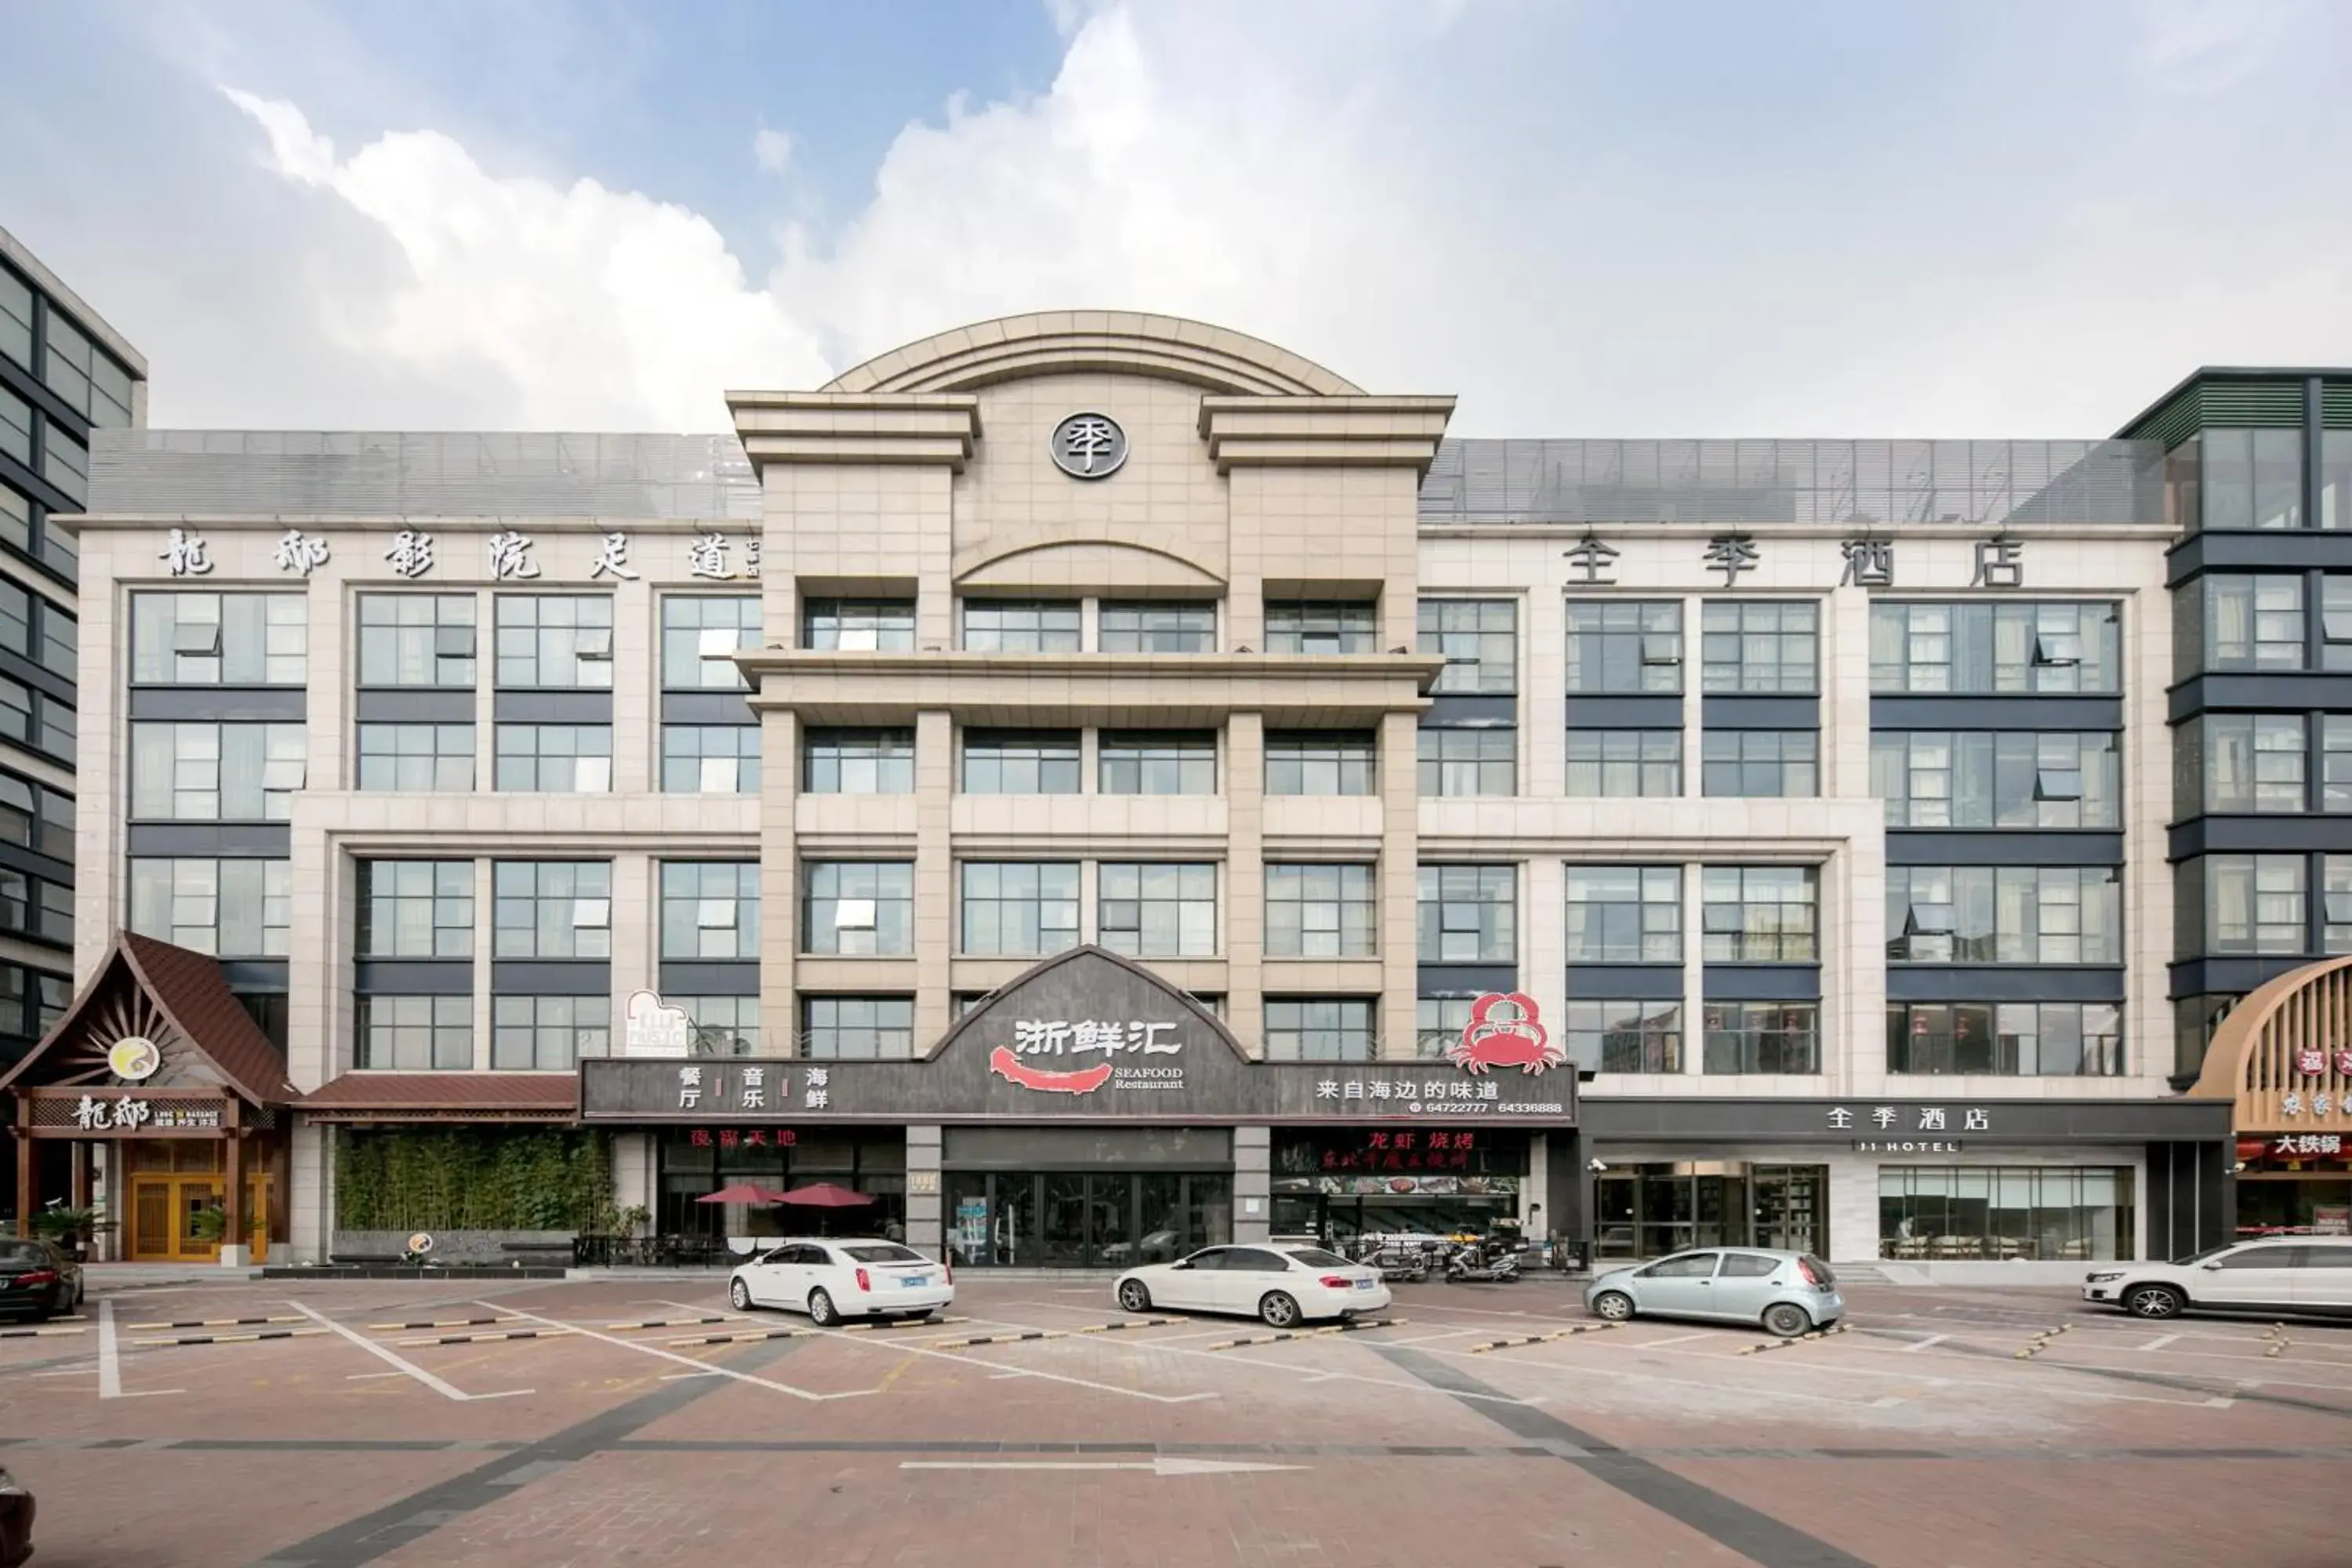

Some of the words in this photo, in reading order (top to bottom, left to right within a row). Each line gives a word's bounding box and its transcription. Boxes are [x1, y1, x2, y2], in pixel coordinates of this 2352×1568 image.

[1563, 533, 2026, 589] 全季酒店
[1014, 1019, 1182, 1058] 浙鲜汇
[1114, 1067, 1184, 1079] SEAFOOD
[1115, 1079, 1185, 1090] Restaurant
[1316, 1080, 1499, 1100] 来自海边的味道
[1426, 1103, 1489, 1112] 64722777
[1826, 1106, 1990, 1131] 全季酒店
[1886, 1142, 1958, 1152] HOTEL
[2275, 1135, 2341, 1154] 大铁锅
